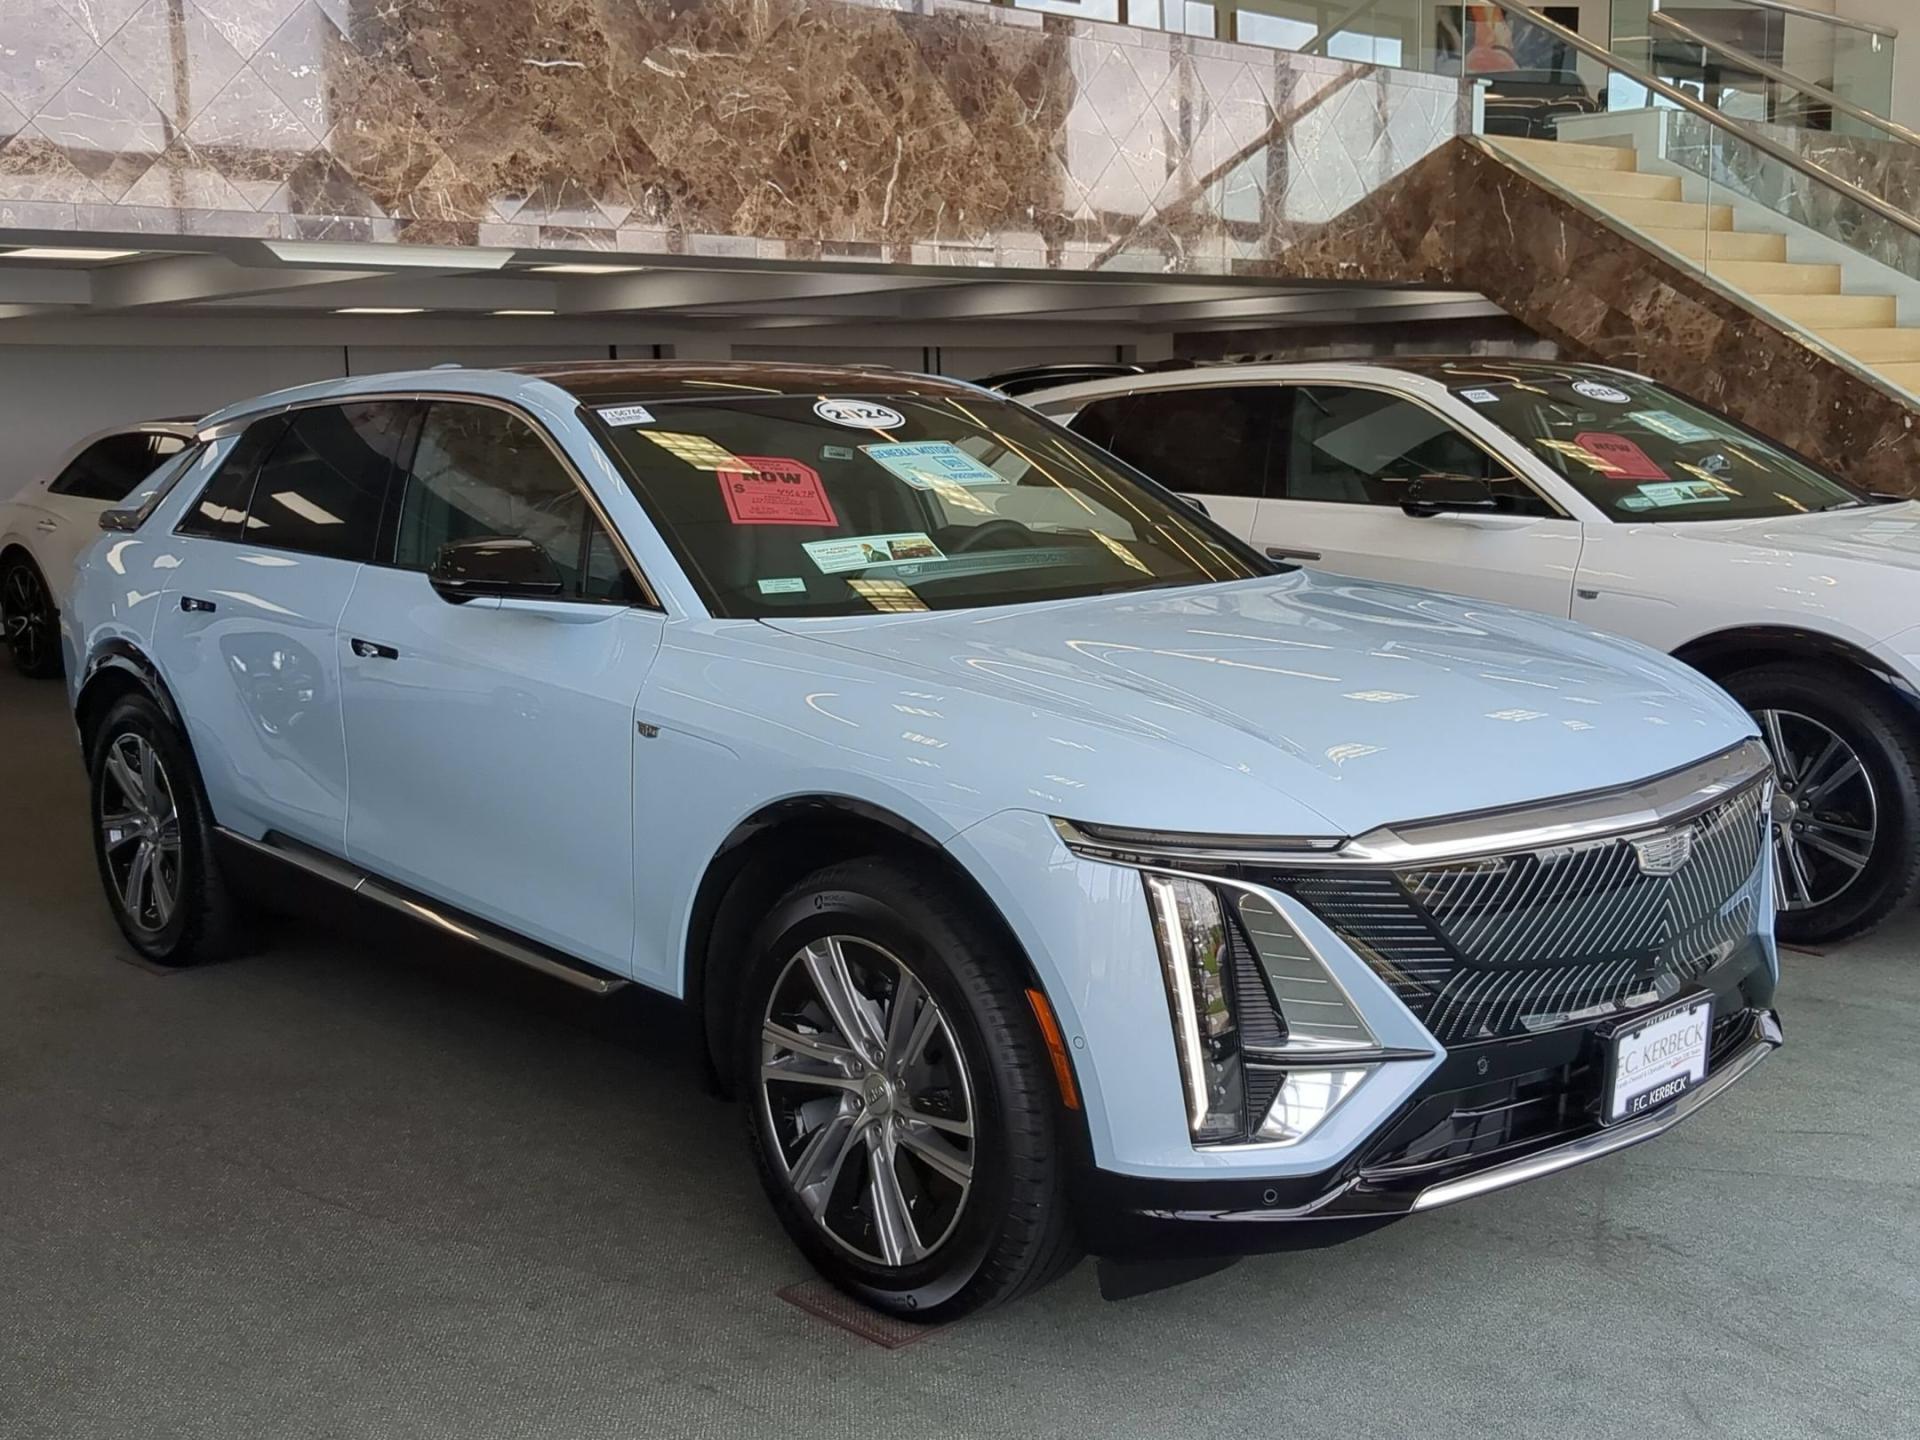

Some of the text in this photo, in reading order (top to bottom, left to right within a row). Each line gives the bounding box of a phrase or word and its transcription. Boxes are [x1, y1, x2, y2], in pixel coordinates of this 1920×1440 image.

[826, 408, 894, 420] 2024
[870, 446, 920, 460] GENERAL
[1592, 442, 1632, 452] NOW
[741, 470, 802, 485] NOW
[1642, 1022, 1704, 1066] KERBECK
[1649, 1076, 1686, 1104] KERBECK
